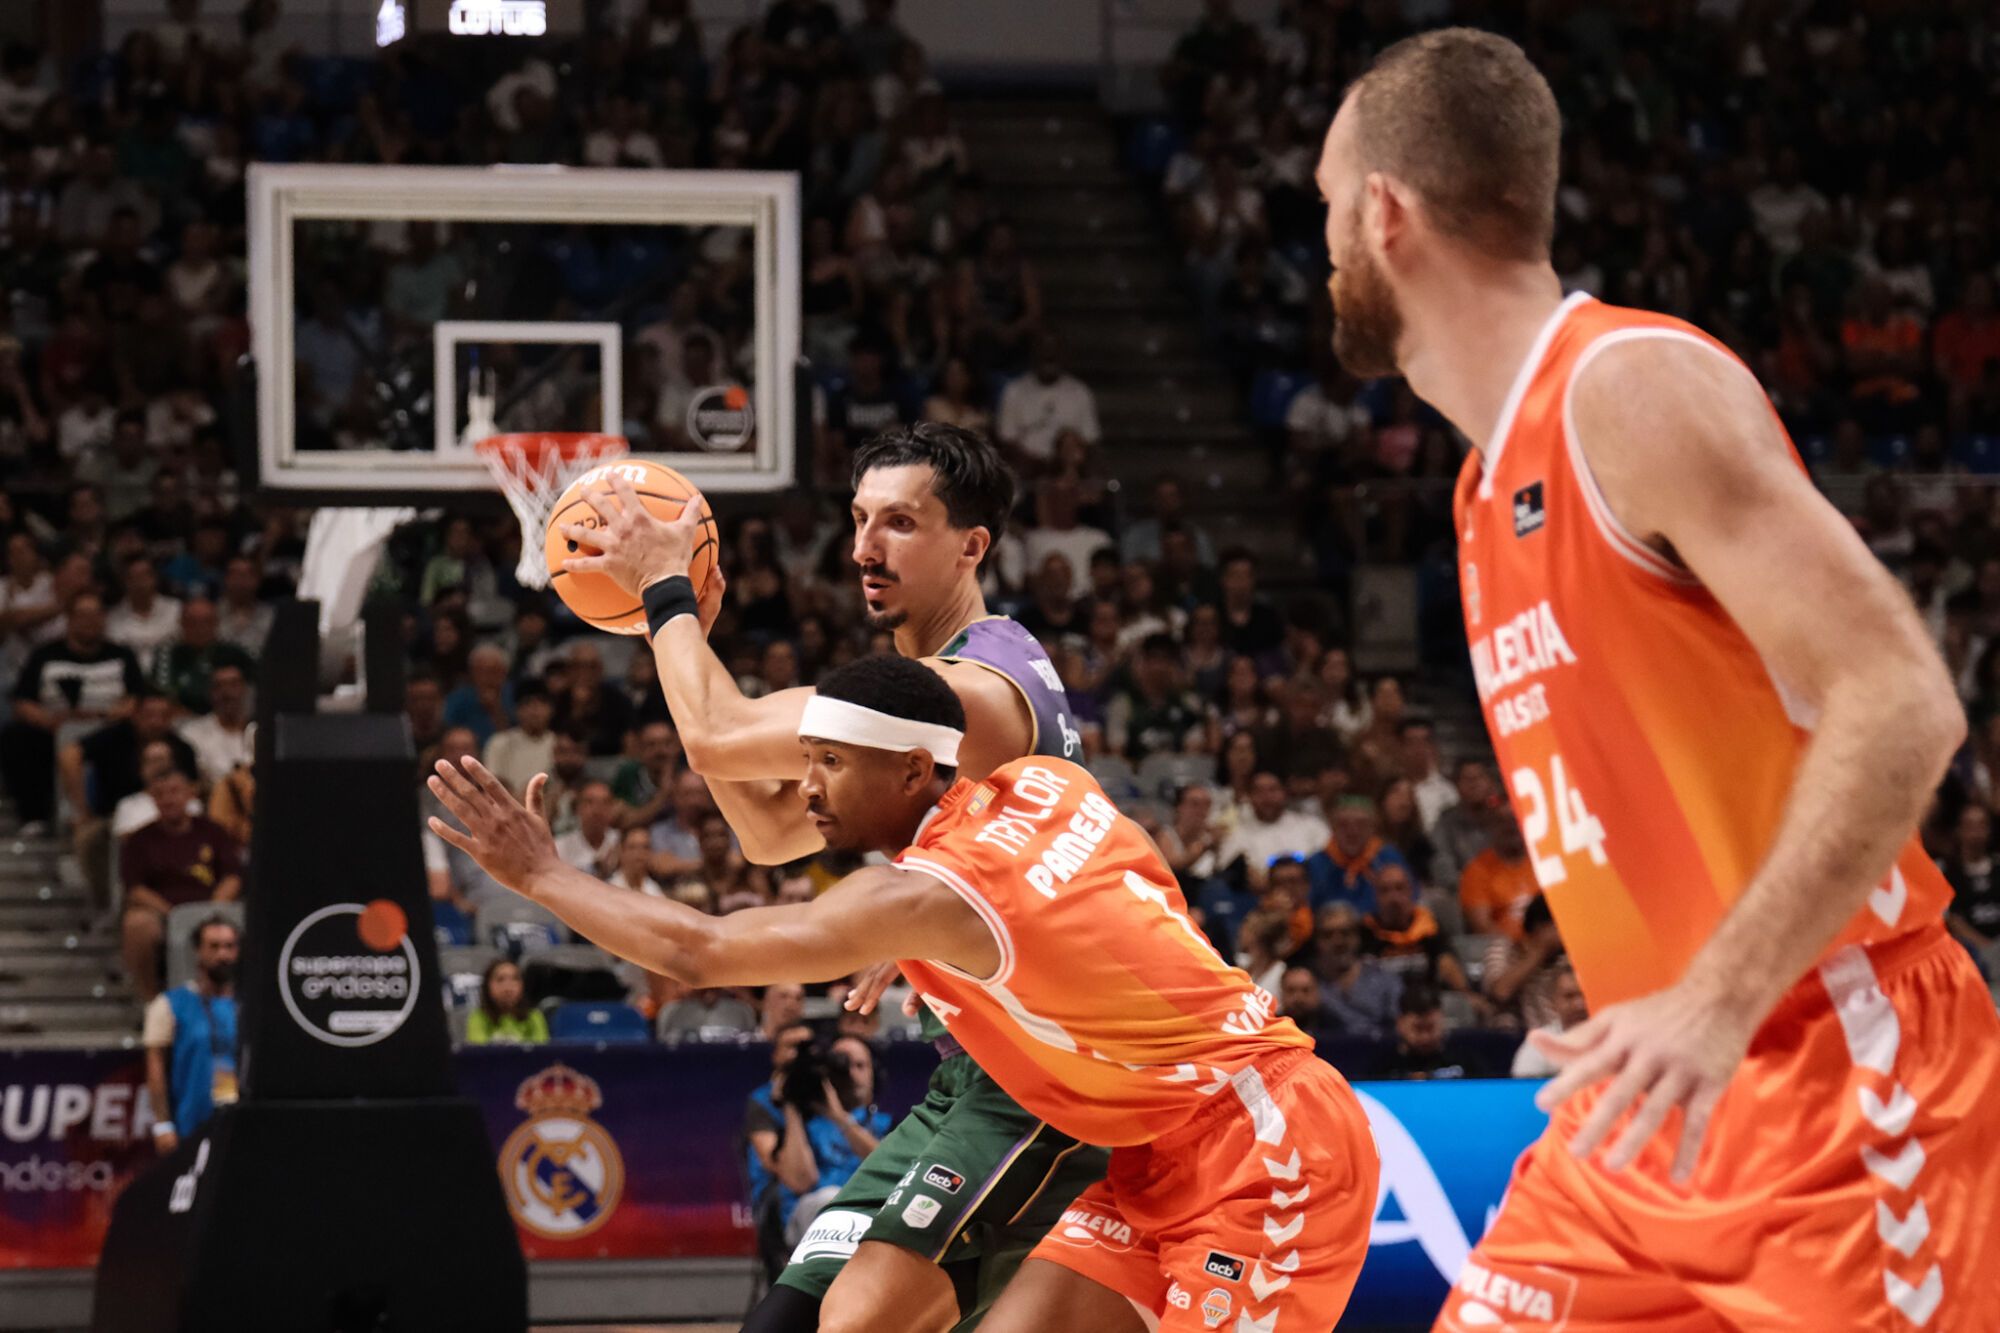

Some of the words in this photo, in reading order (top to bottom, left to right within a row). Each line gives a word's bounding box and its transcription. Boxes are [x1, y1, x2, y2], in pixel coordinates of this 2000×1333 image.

[975, 766, 1070, 856] TAYLOR
[1024, 792, 1119, 900] PAMESA
[1511, 754, 1607, 888] 24
[928, 1173, 953, 1189] acb
[1208, 1261, 1235, 1278] acb
